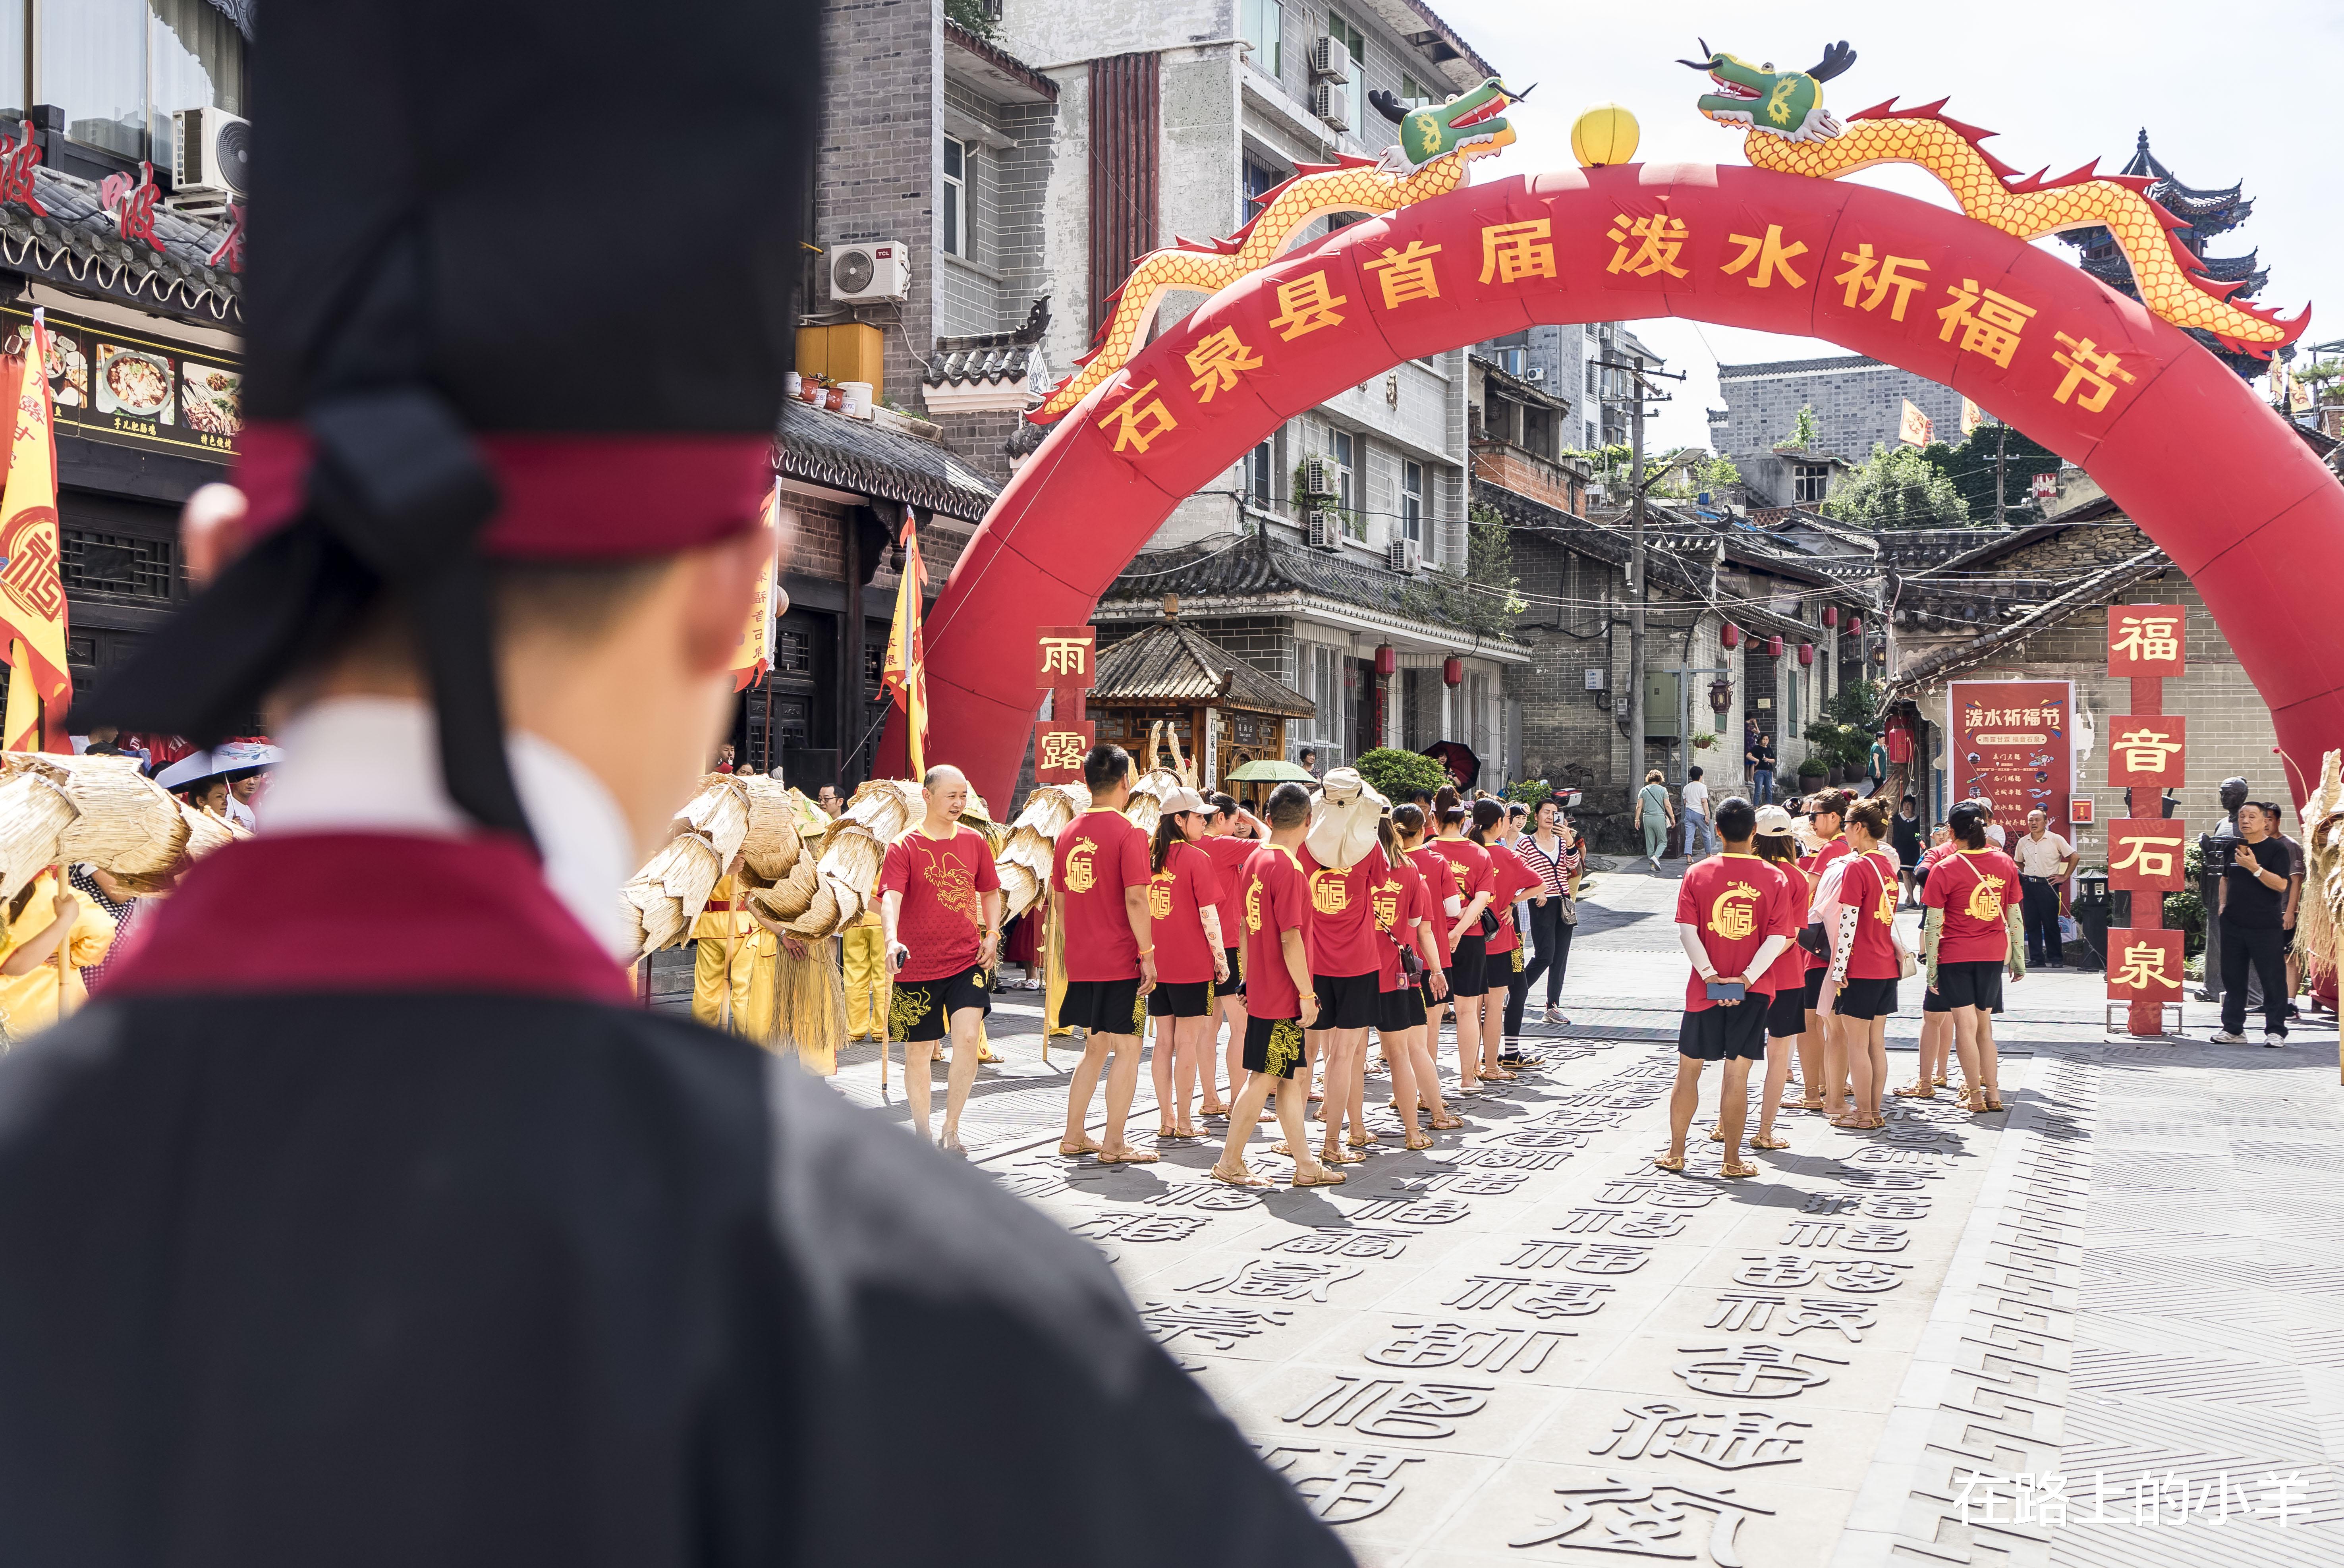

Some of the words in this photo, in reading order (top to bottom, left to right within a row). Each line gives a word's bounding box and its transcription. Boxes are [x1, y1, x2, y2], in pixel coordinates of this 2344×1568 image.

[1098, 213, 2137, 455] 石泉县首届泼水祈福节
[114, 418, 156, 436] 芋儿肥肠鸡
[201, 434, 232, 450] 特色烧烤
[1039, 637, 1093, 770] 雨露
[1966, 708, 2059, 727] 泼水祈福节
[2110, 617, 2182, 989] 福音石泉
